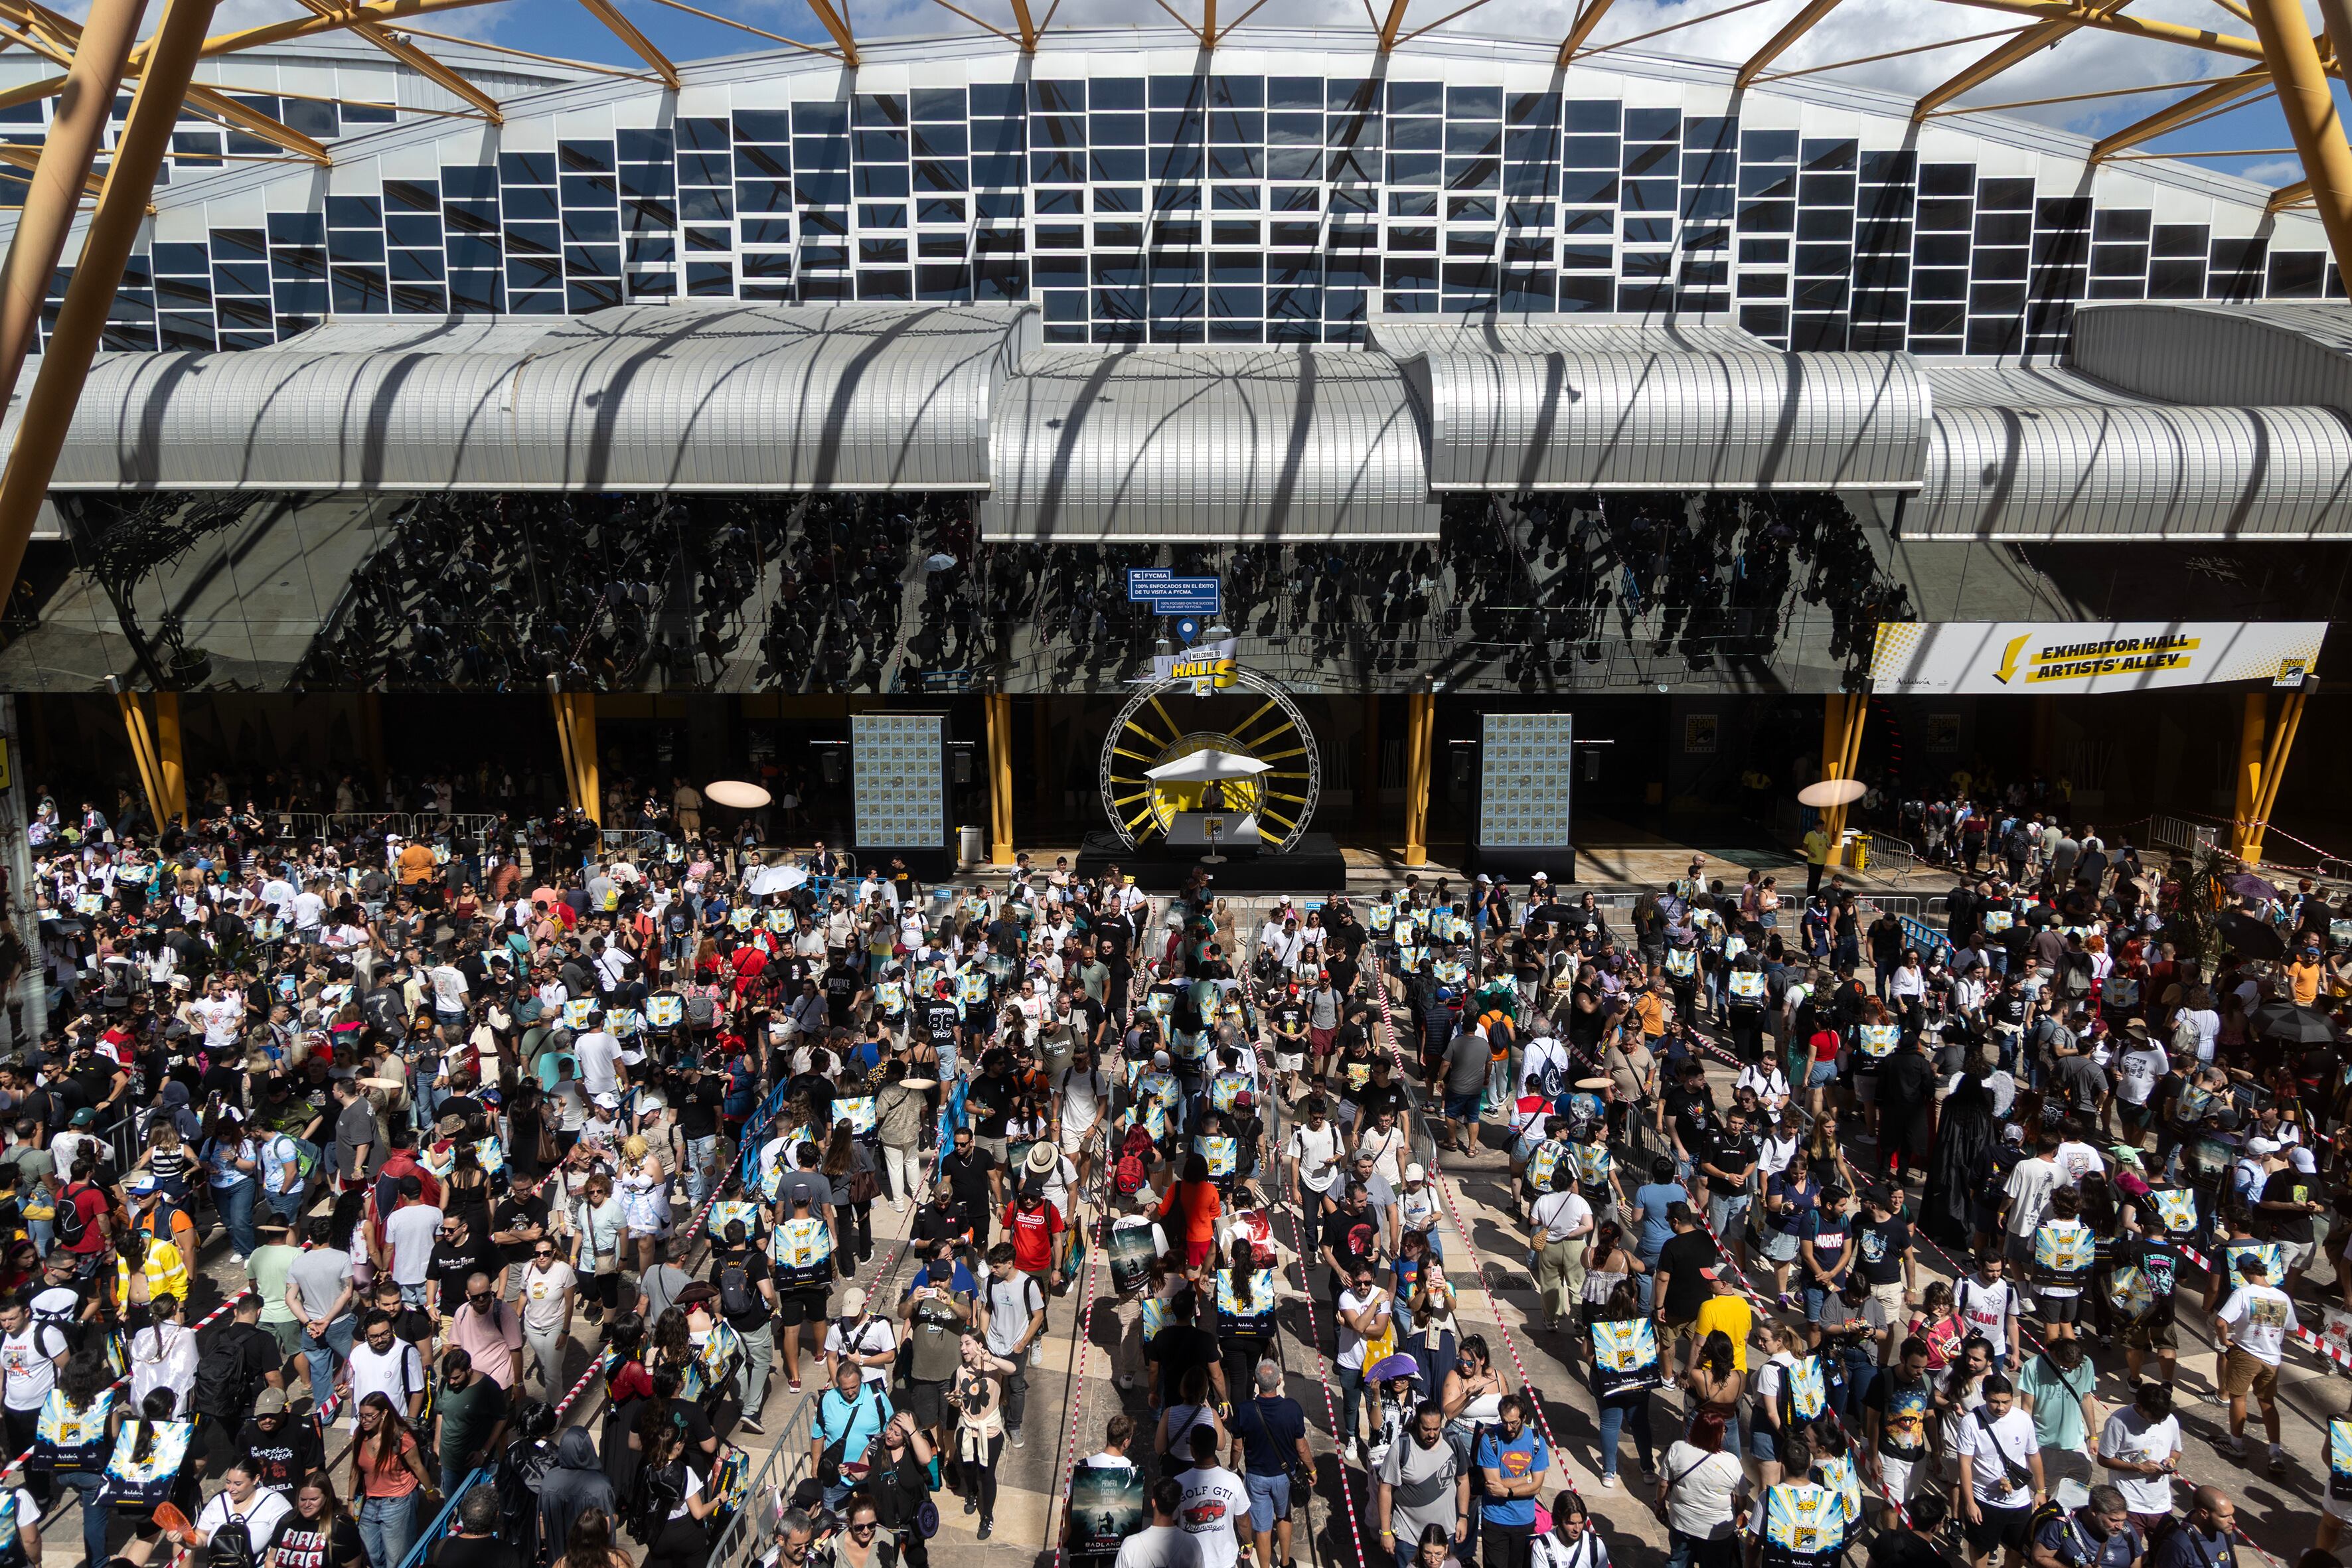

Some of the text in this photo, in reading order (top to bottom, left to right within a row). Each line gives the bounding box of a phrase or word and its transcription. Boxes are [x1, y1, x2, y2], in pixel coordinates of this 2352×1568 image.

[2041, 634, 2188, 660] EXHIBITOR HALL
[2037, 653, 2181, 678] ARTISTS' ALLEY
[2276, 660, 2290, 681] COMIC
[1698, 720, 1715, 728] CON
[1688, 720, 1697, 746] COMIC
[828, 978, 850, 989] SCARFACE
[929, 1013, 955, 1032] 86
[1045, 1039, 1071, 1050] Breaking
[1018, 1214, 1043, 1223] Nintendo
[460, 1257, 475, 1267] Titan
[1124, 1271, 1150, 1287] BADLANDS
[1971, 1310, 1998, 1326] BANG
[1615, 1328, 1632, 1339] 2025
[1101, 1487, 1116, 1496] CACERÍA
[1181, 1486, 1233, 1502] GOLF GTI
[1798, 1501, 1816, 1511] 2025
[1794, 1528, 1802, 1547] COMIC
